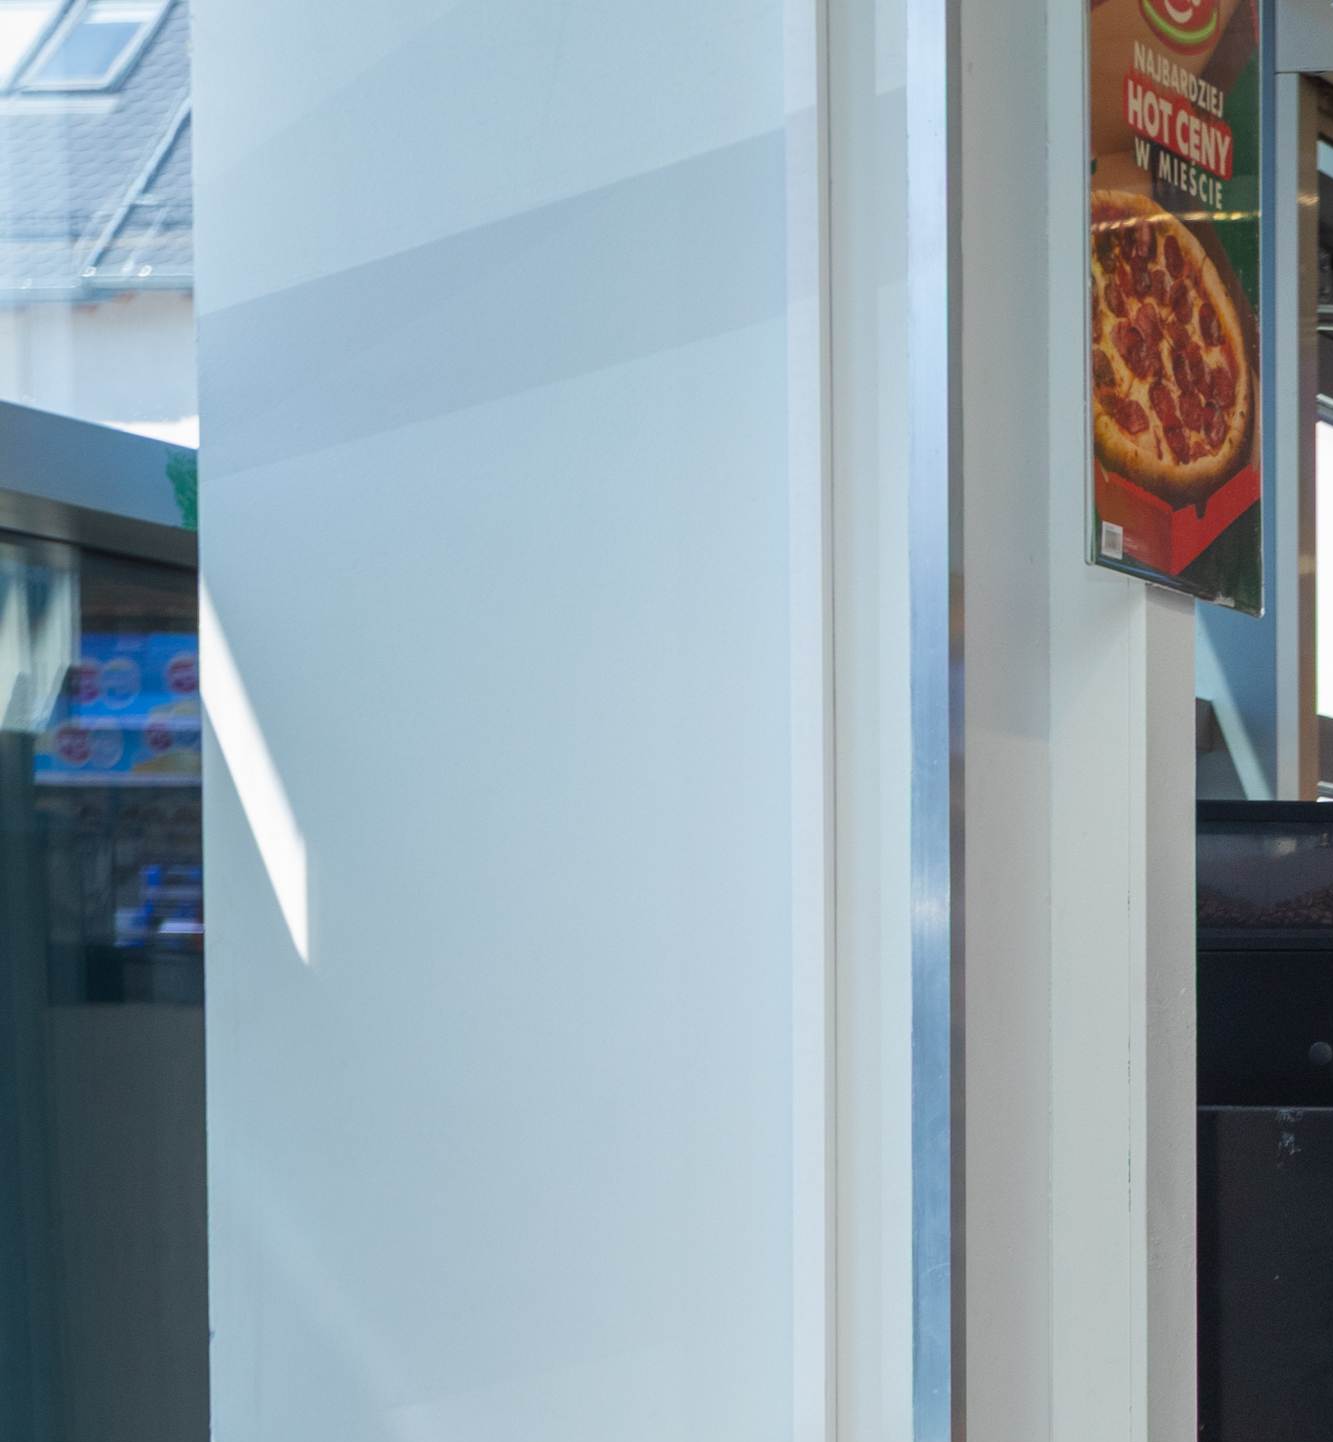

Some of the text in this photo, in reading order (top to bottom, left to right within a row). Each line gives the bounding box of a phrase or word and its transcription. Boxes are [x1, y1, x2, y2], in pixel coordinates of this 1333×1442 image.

[1134, 40, 1224, 118] NAJBARDZIEJ
[1128, 79, 1231, 176] HOT CENY
[1134, 136, 1223, 209] W MIEŚCIE
